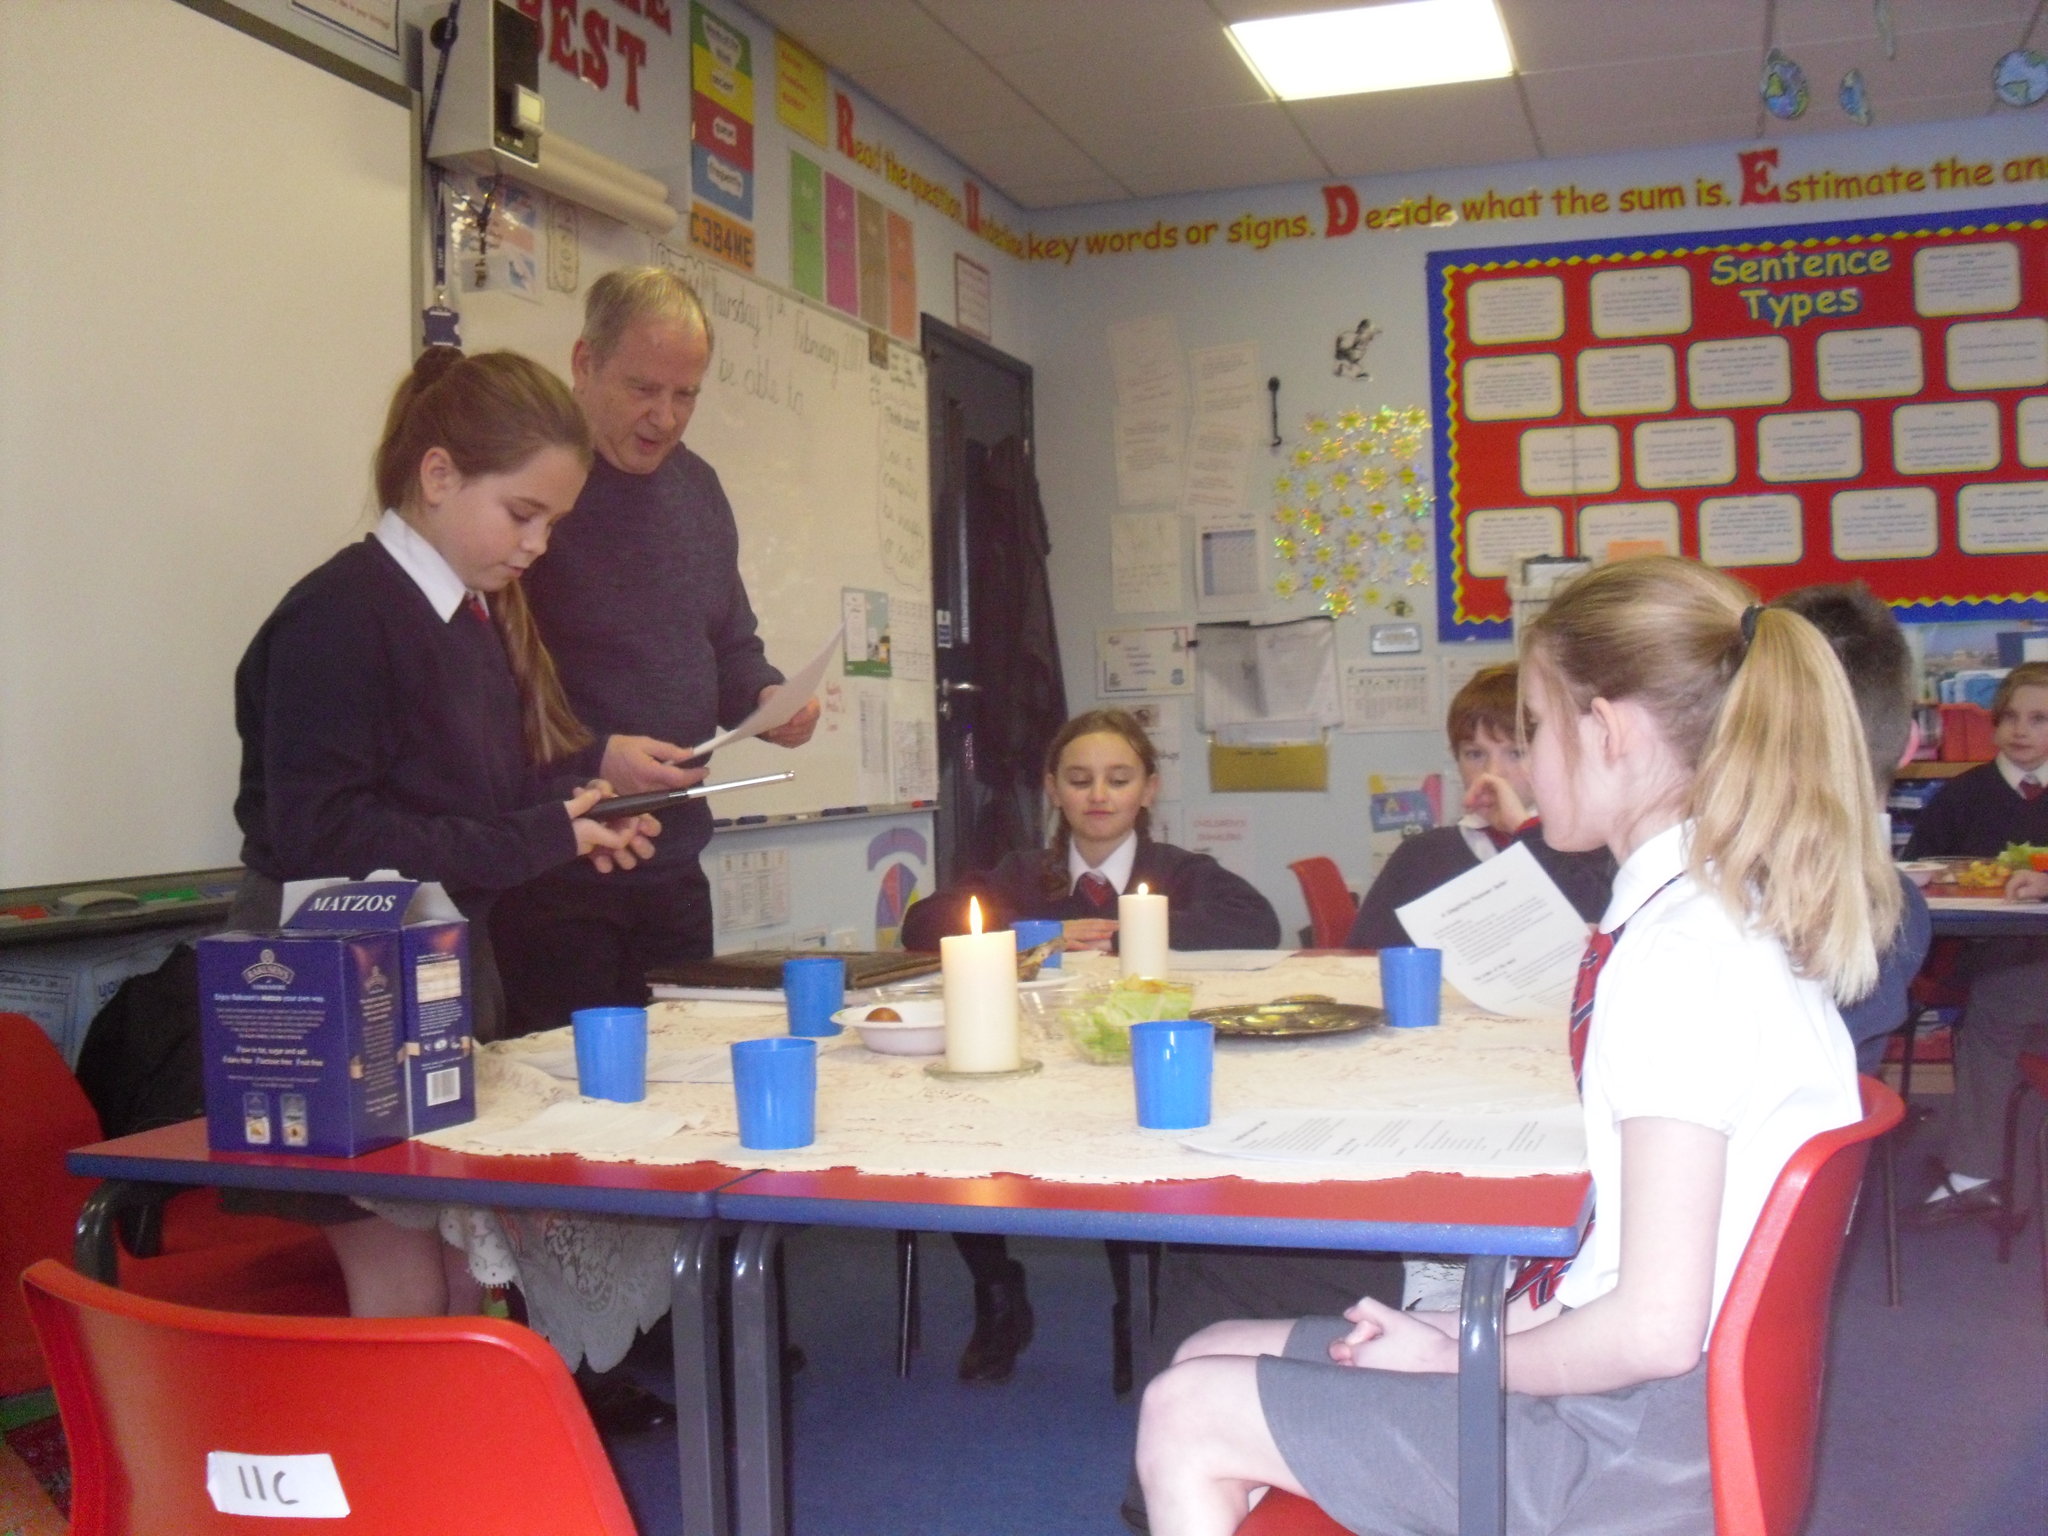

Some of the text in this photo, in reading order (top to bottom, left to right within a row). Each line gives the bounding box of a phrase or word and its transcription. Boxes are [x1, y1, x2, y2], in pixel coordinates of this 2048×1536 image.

[1738, 148, 1927, 206] Estimate
[1930, 158, 1995, 190] the
[1322, 184, 1455, 238] Decide
[1461, 188, 1542, 223] what
[1551, 186, 1610, 216] the
[1619, 184, 1686, 214] sum
[1027, 231, 1079, 265] key
[1085, 219, 1178, 256] words
[1185, 219, 1218, 246] or
[1709, 247, 1893, 287] Sentence
[1738, 286, 1860, 329] Types
[308, 894, 396, 913] MATZOS
